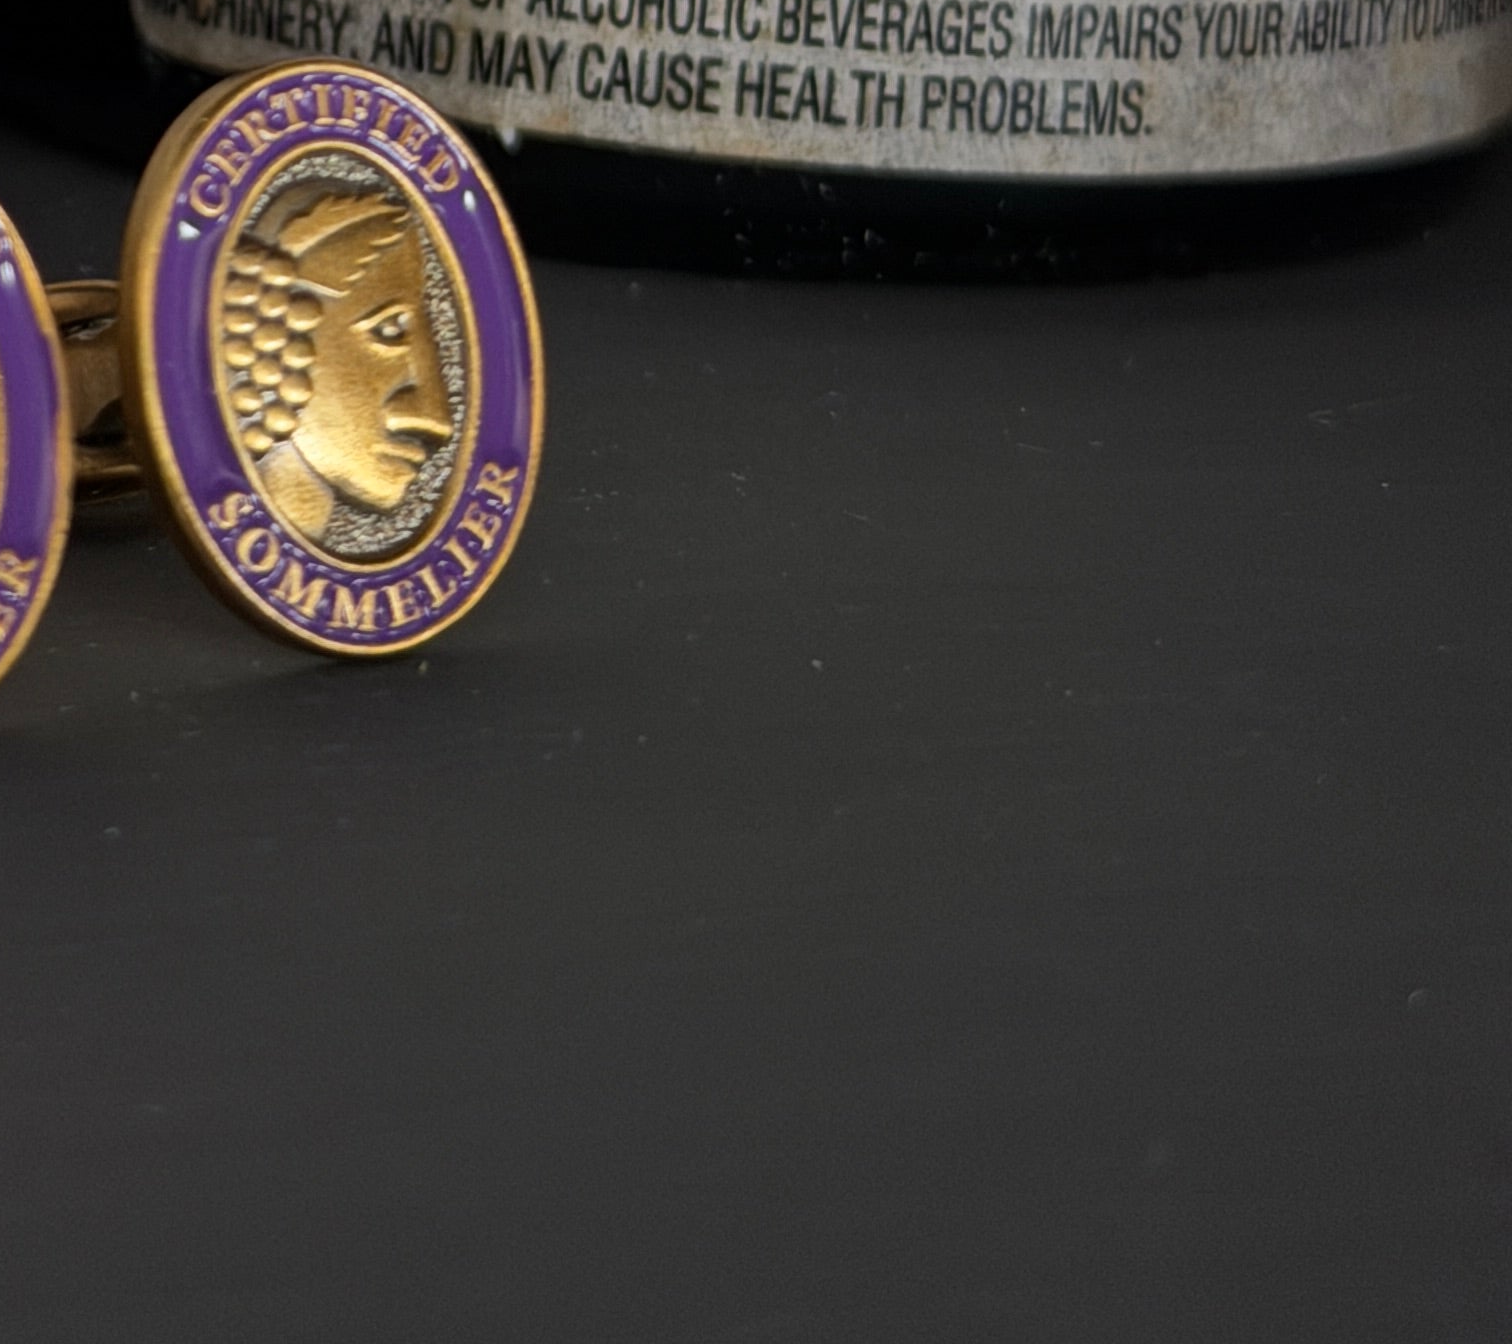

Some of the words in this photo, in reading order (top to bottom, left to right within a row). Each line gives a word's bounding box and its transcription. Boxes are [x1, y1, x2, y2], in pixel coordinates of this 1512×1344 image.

[369, 12, 456, 76] AND
[467, 25, 567, 95] MAY
[575, 41, 723, 115] CAUSE
[734, 59, 906, 129] HEALTH
[918, 73, 1153, 138] PROBLEMS.
[1025, 0, 1184, 61] IMPAIRS
[1195, 1, 1283, 60] YOUR
[187, 82, 462, 219] CERTIFIED
[207, 460, 519, 634] SOMMELIER
